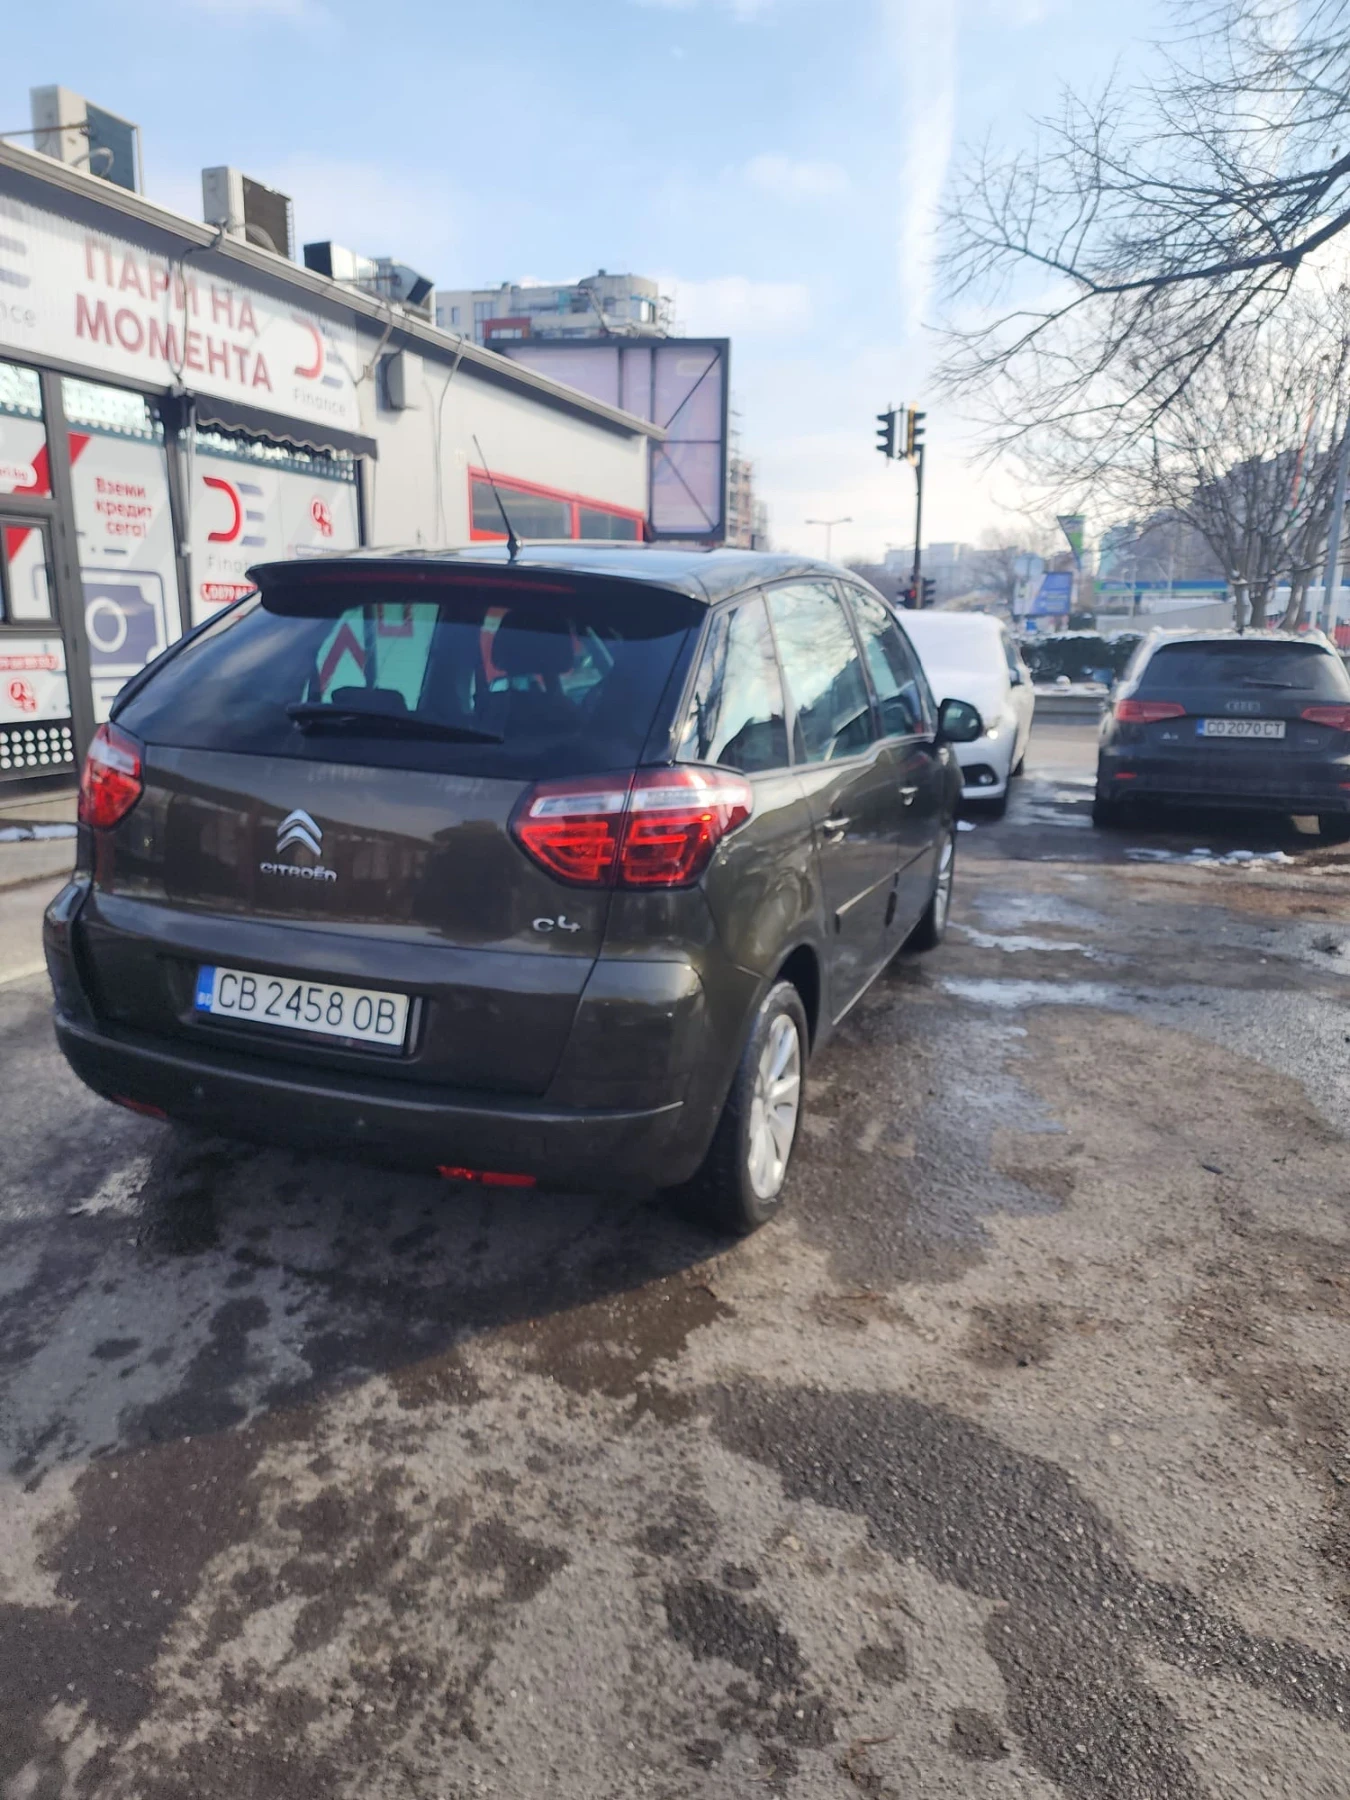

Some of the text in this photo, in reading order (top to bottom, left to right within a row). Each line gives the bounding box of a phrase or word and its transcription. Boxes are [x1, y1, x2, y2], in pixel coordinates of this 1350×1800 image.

[84, 237, 260, 337] ПАРИ НА
[75, 293, 273, 393] МОМЕНТА
[95, 476, 146, 498] Вземи
[95, 500, 152, 519] кредит
[1228, 721, 1262, 735] 2070
[1263, 722, 1282, 736] CT
[533, 914, 581, 932] C4
[218, 973, 395, 1035] CB 2458 OB
